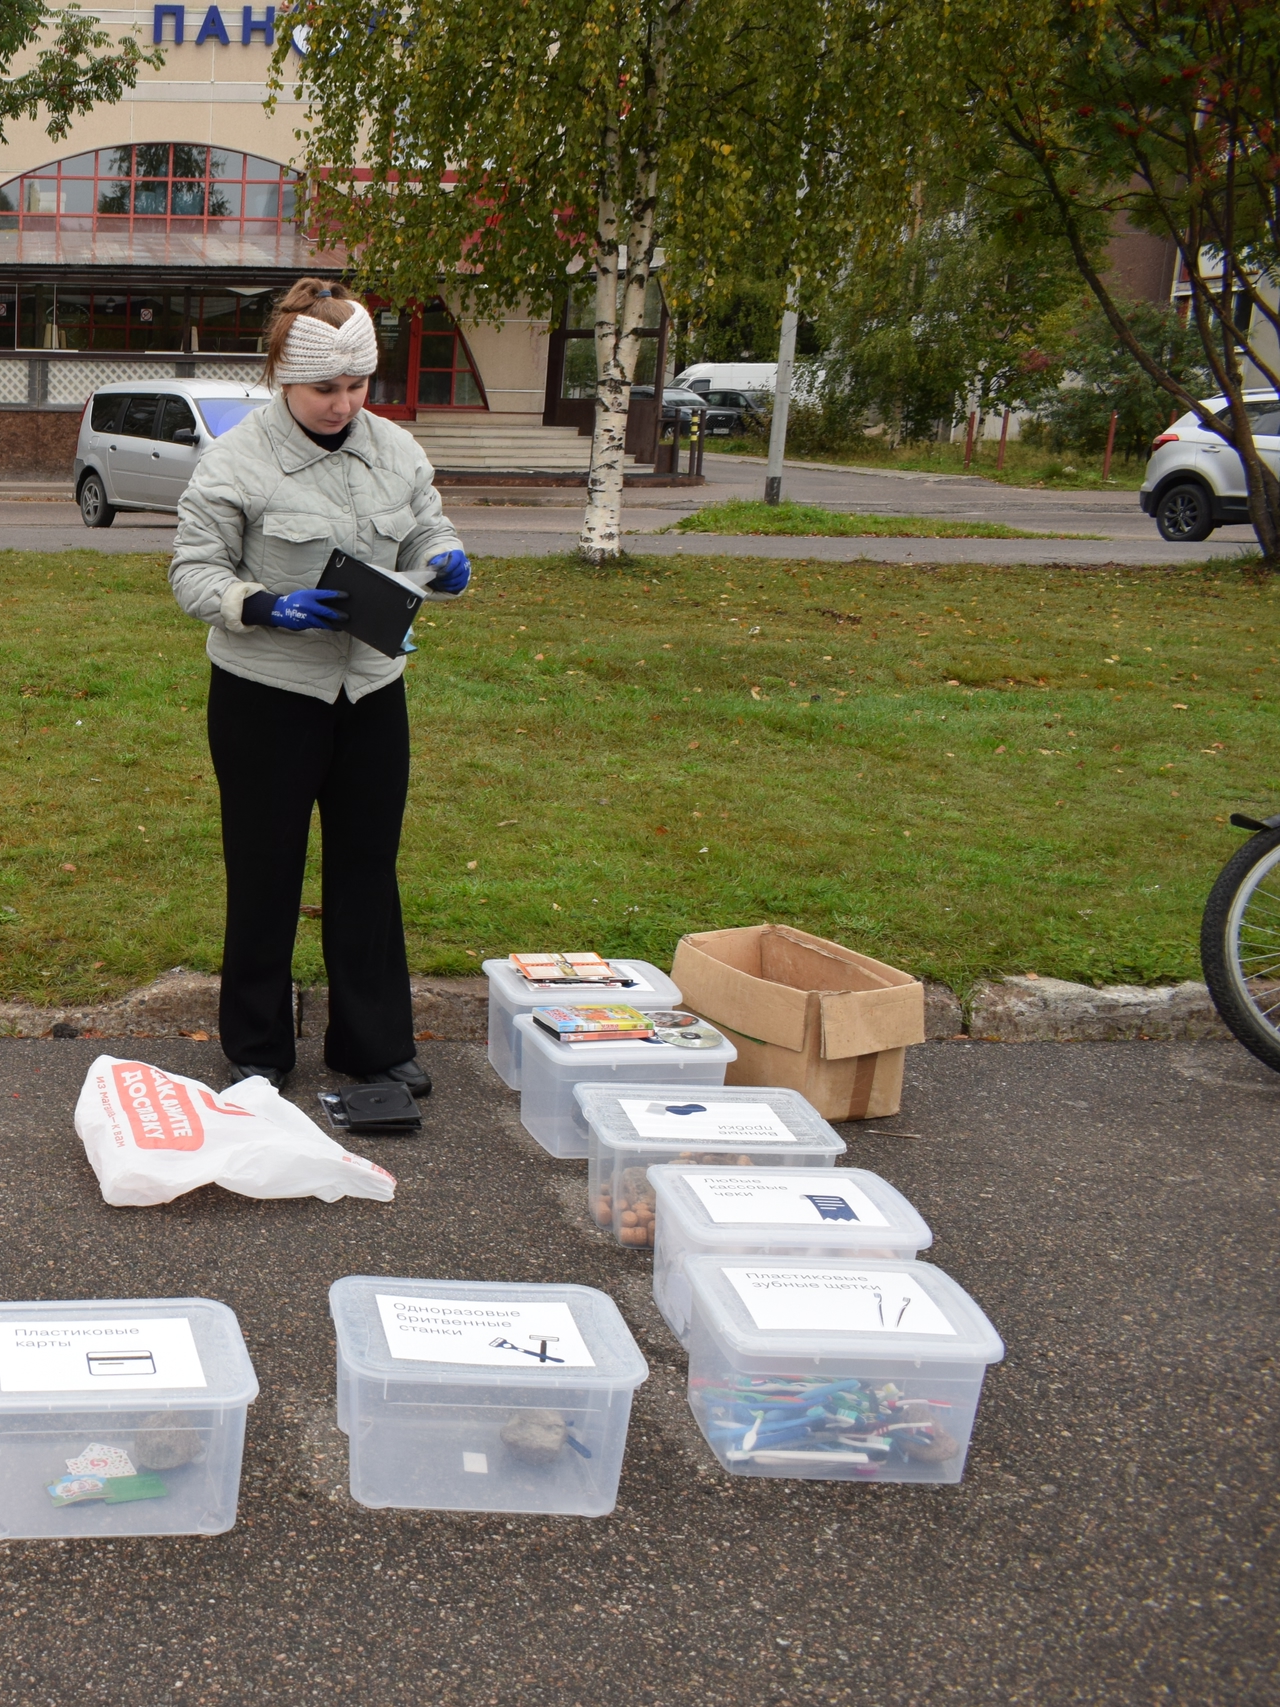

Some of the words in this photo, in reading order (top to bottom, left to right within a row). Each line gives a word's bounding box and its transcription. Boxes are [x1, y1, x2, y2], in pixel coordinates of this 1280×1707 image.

[714, 1190, 754, 1198] чеки
[745, 1271, 869, 1281] Пластиковые
[751, 1279, 820, 1290] зубные
[824, 1282, 882, 1291] щетки
[393, 1302, 521, 1317] Одноразовые
[396, 1312, 512, 1328] бритвенные
[14, 1327, 140, 1337] Пластиковые
[399, 1324, 463, 1336] станки
[15, 1339, 72, 1349] карты
